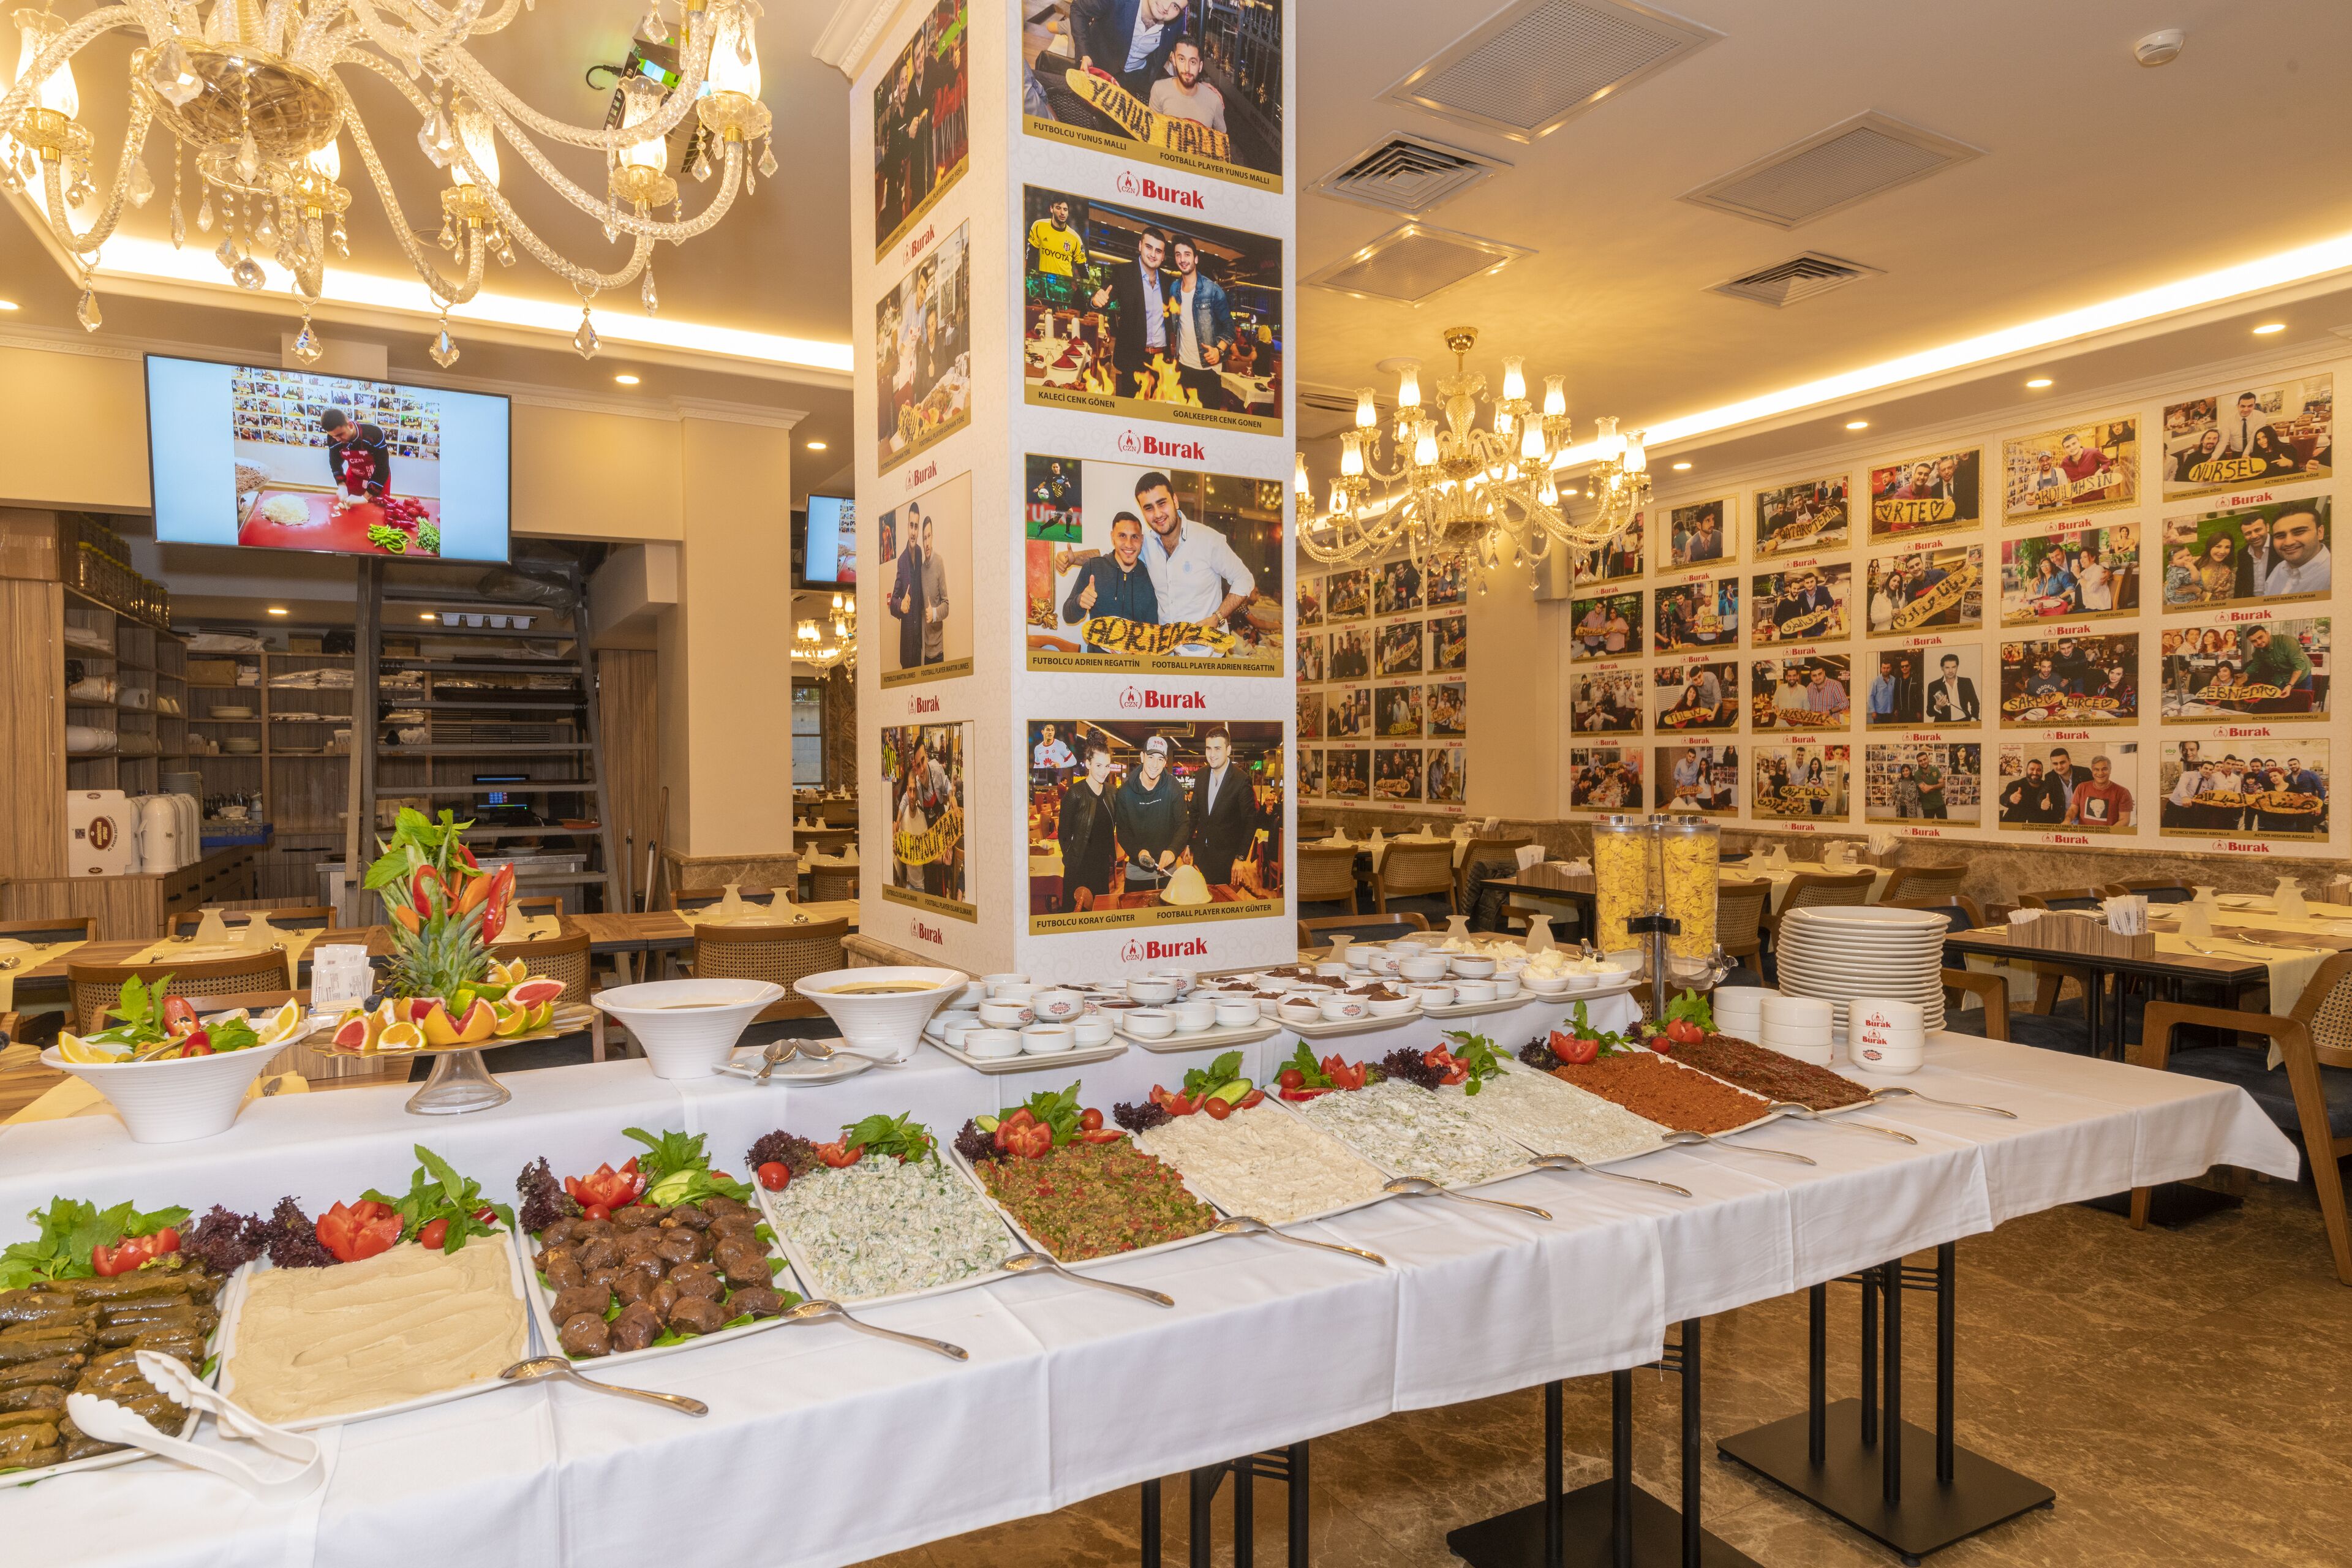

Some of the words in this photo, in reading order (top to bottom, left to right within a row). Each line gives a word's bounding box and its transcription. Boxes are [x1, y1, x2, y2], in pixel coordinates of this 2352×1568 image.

[1034, 123, 1075, 138] FUTBOLCU
[1076, 132, 1102, 145] YUNUS
[1104, 138, 1126, 151] MALLI
[1160, 153, 1196, 168] FOOTBALL
[1198, 161, 1224, 174] PLAYER
[1225, 167, 1248, 179] YUNUS
[1249, 173, 1269, 184] MALLI
[919, 200, 933, 214] FOOTBALL
[933, 187, 944, 200] PLAYER
[944, 174, 954, 189] SAMED
[1121, 185, 1135, 194] CZN
[1142, 179, 1204, 209] Burak
[911, 224, 935, 258] Burak
[1041, 247, 1069, 262] TOYOTA
[1038, 391, 1065, 402] KALECİ
[1066, 395, 1086, 405] CENK
[1088, 398, 1115, 408] GÖNEN
[1173, 410, 1217, 423] GOALKEEPER
[1219, 416, 1236, 425] CENK
[919, 437, 932, 447] FOOTBALL
[933, 430, 943, 440] PLAYER
[944, 421, 956, 434] GÖKHAN
[1144, 435, 1204, 460] Burak
[914, 461, 937, 486] Burak
[2192, 460, 2263, 481] NURSEL
[2231, 492, 2272, 506] Burak
[1894, 502, 1926, 522] RTE
[2058, 519, 2092, 531] Burak
[1915, 540, 1943, 551] Burak
[1793, 558, 1817, 568] Burak
[1689, 573, 1709, 582] Burak
[1600, 586, 1618, 595] Burak
[2231, 610, 2272, 621] Burak
[2057, 625, 2090, 635] Burak
[1913, 636, 1942, 646] Burak
[1792, 647, 1816, 655] Burak
[1033, 657, 1073, 666] FUTBOLCU
[2036, 684, 2057, 694] BROOKLYN
[917, 695, 940, 713] Burak
[1145, 690, 1205, 709] Burak
[2056, 731, 2089, 740] Burak
[2229, 727, 2270, 736] Burak
[1912, 828, 1940, 837] Burak
[2055, 835, 2089, 844] Burak
[2228, 842, 2269, 852] Burak
[925, 899, 939, 908] FOOTBALL
[939, 902, 949, 911] PLAYER
[1157, 910, 1193, 919] FOOTBALL
[1194, 908, 1219, 916] PLAYER
[1221, 906, 1243, 914] KORAY
[1245, 904, 1271, 913] GÜNTER
[1037, 918, 1076, 928] FUTBOLCU
[1079, 916, 1104, 925] KORAY
[1106, 914, 1134, 923] GÜNTER
[919, 923, 943, 945] Burak
[1147, 938, 1207, 959] Burak
[1863, 1036, 1887, 1045] Burak
